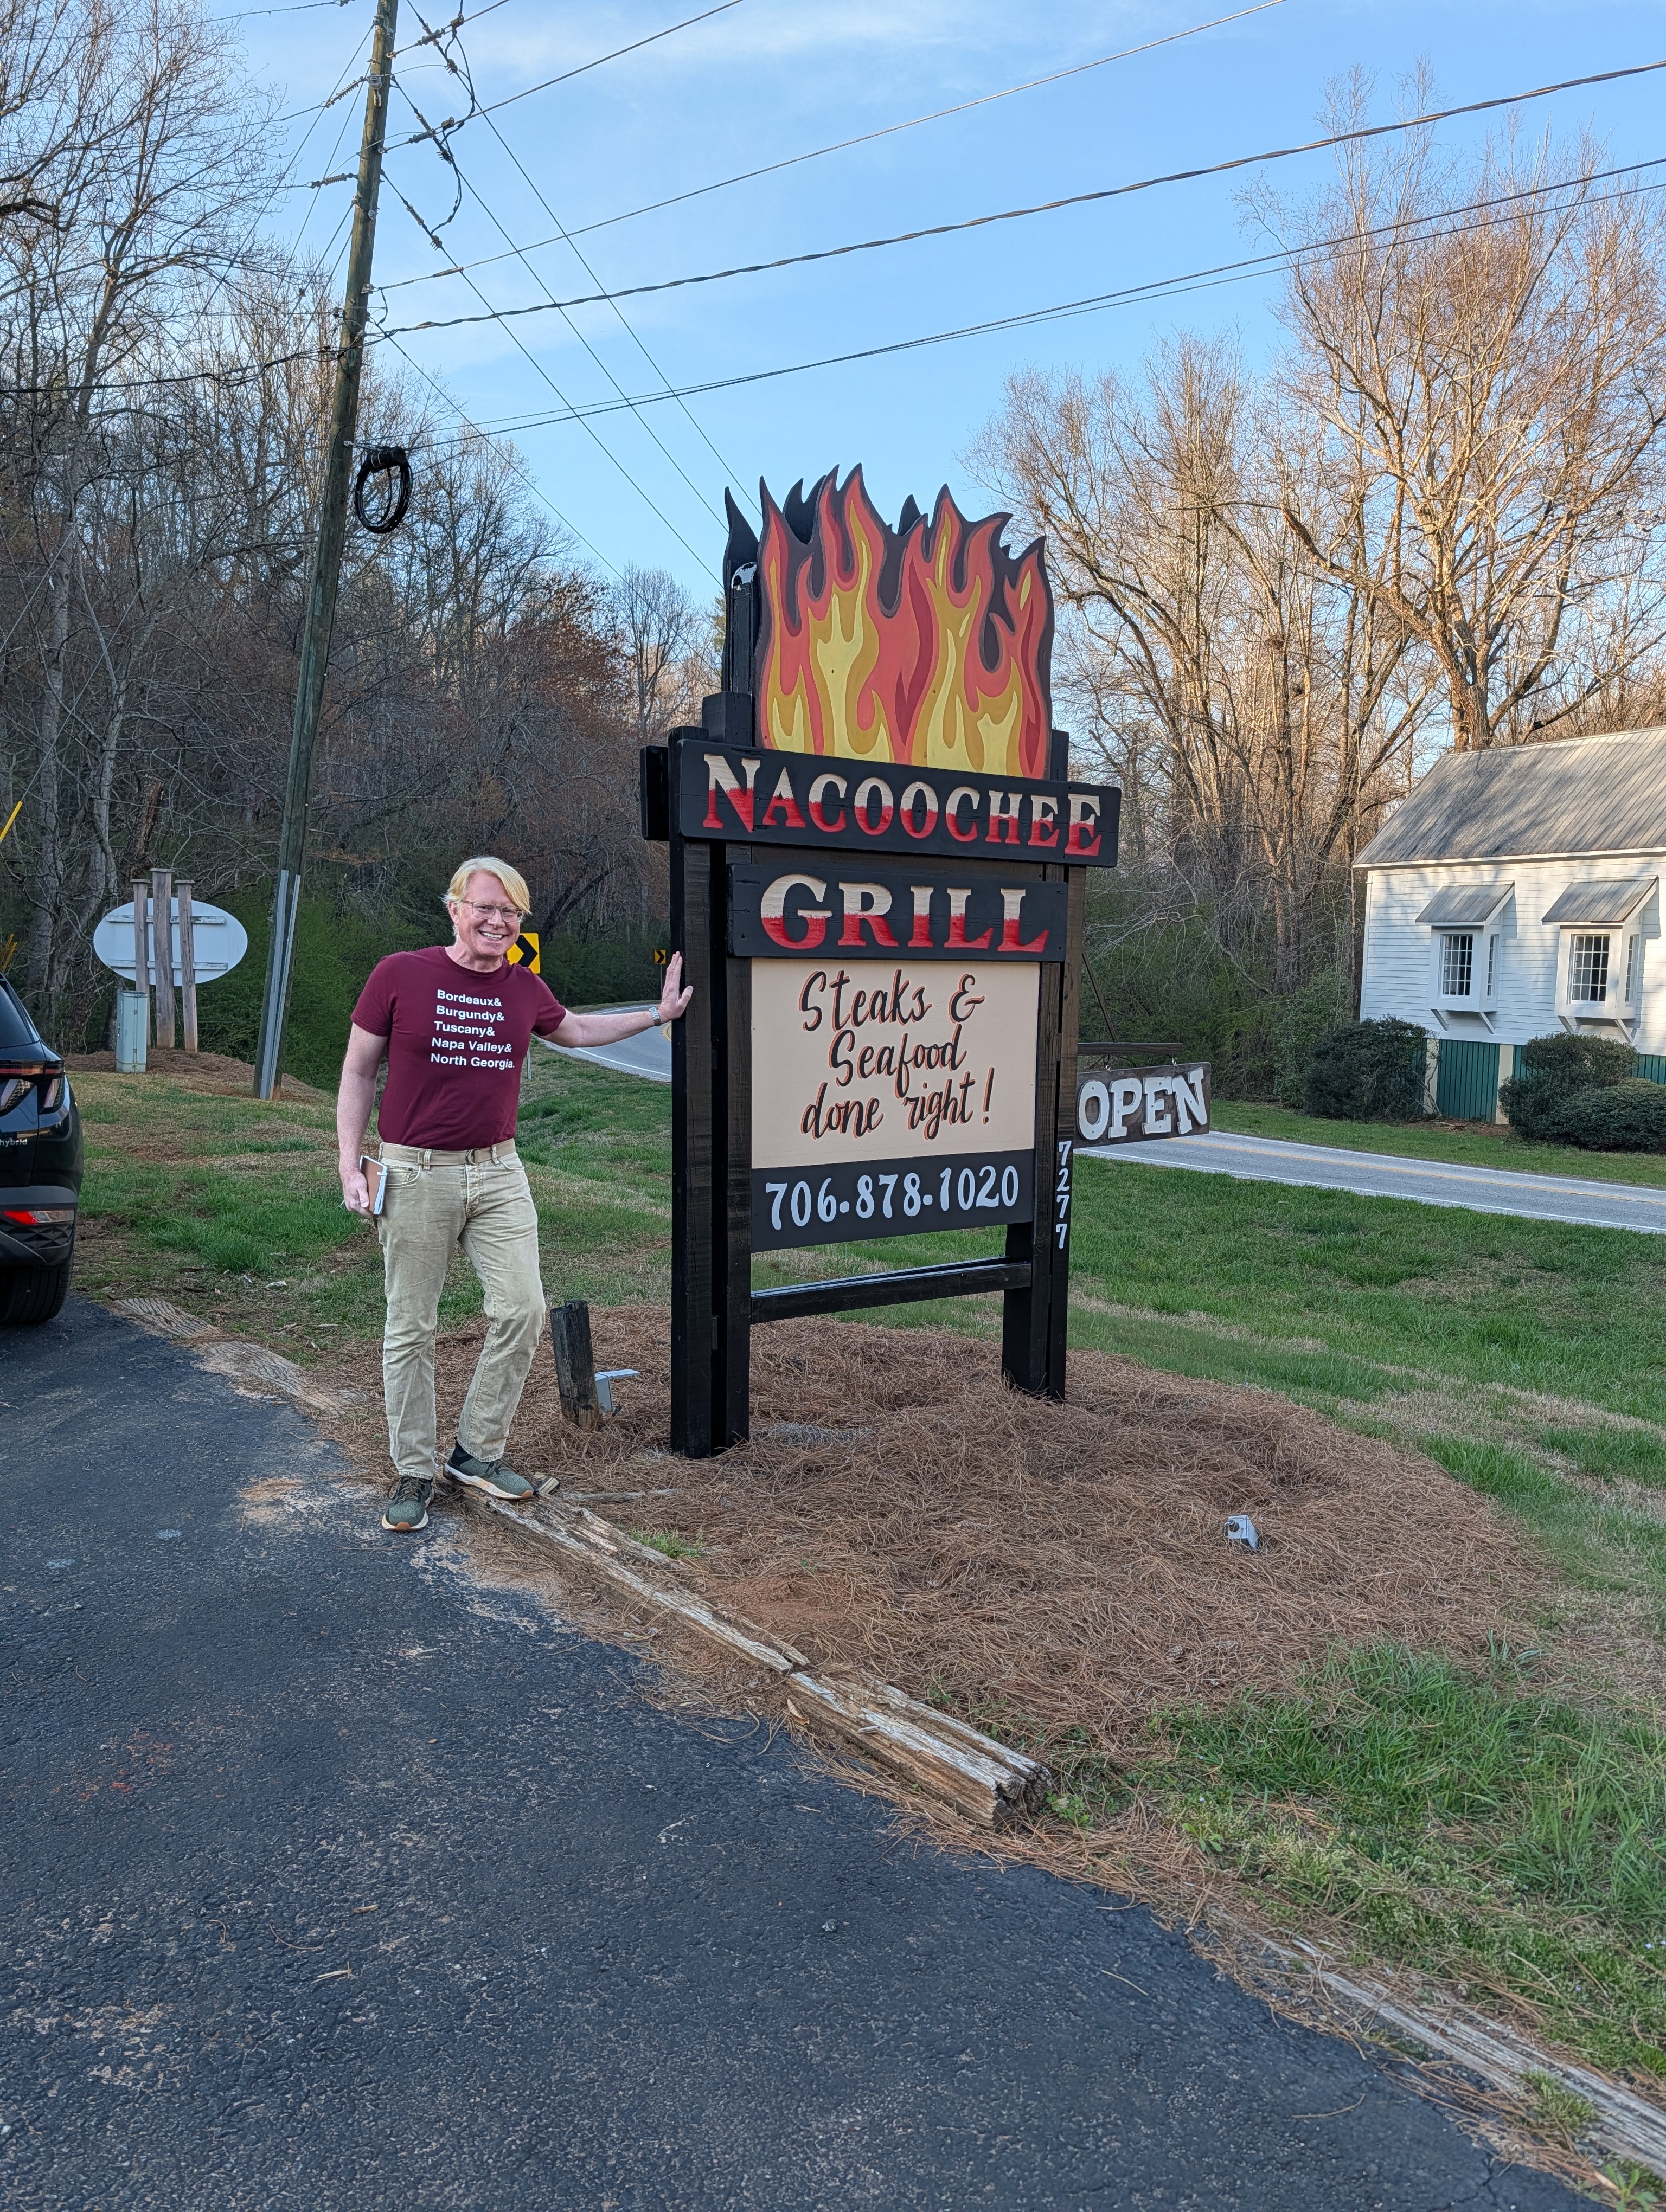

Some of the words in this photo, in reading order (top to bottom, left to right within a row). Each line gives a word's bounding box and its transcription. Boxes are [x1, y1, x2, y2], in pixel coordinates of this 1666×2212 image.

[703, 754, 1101, 856] NACOOCHEE
[760, 874, 1049, 953] GRILL
[436, 1005, 505, 1023] Burgundy&
[437, 989, 502, 1007] Bordeaux&
[798, 968, 933, 1031] Steaks
[948, 973, 985, 1024] &
[431, 1037, 464, 1050] Napa
[469, 1041, 512, 1054] Valley&
[434, 1021, 495, 1037] Tuscany&
[431, 1053, 467, 1066] North
[471, 1057, 515, 1070] Georgia.
[828, 1024, 967, 1099] Seafood
[801, 1082, 884, 1139] done
[1077, 1067, 1208, 1140] OPEN
[1055, 1140, 1072, 1249] 7277
